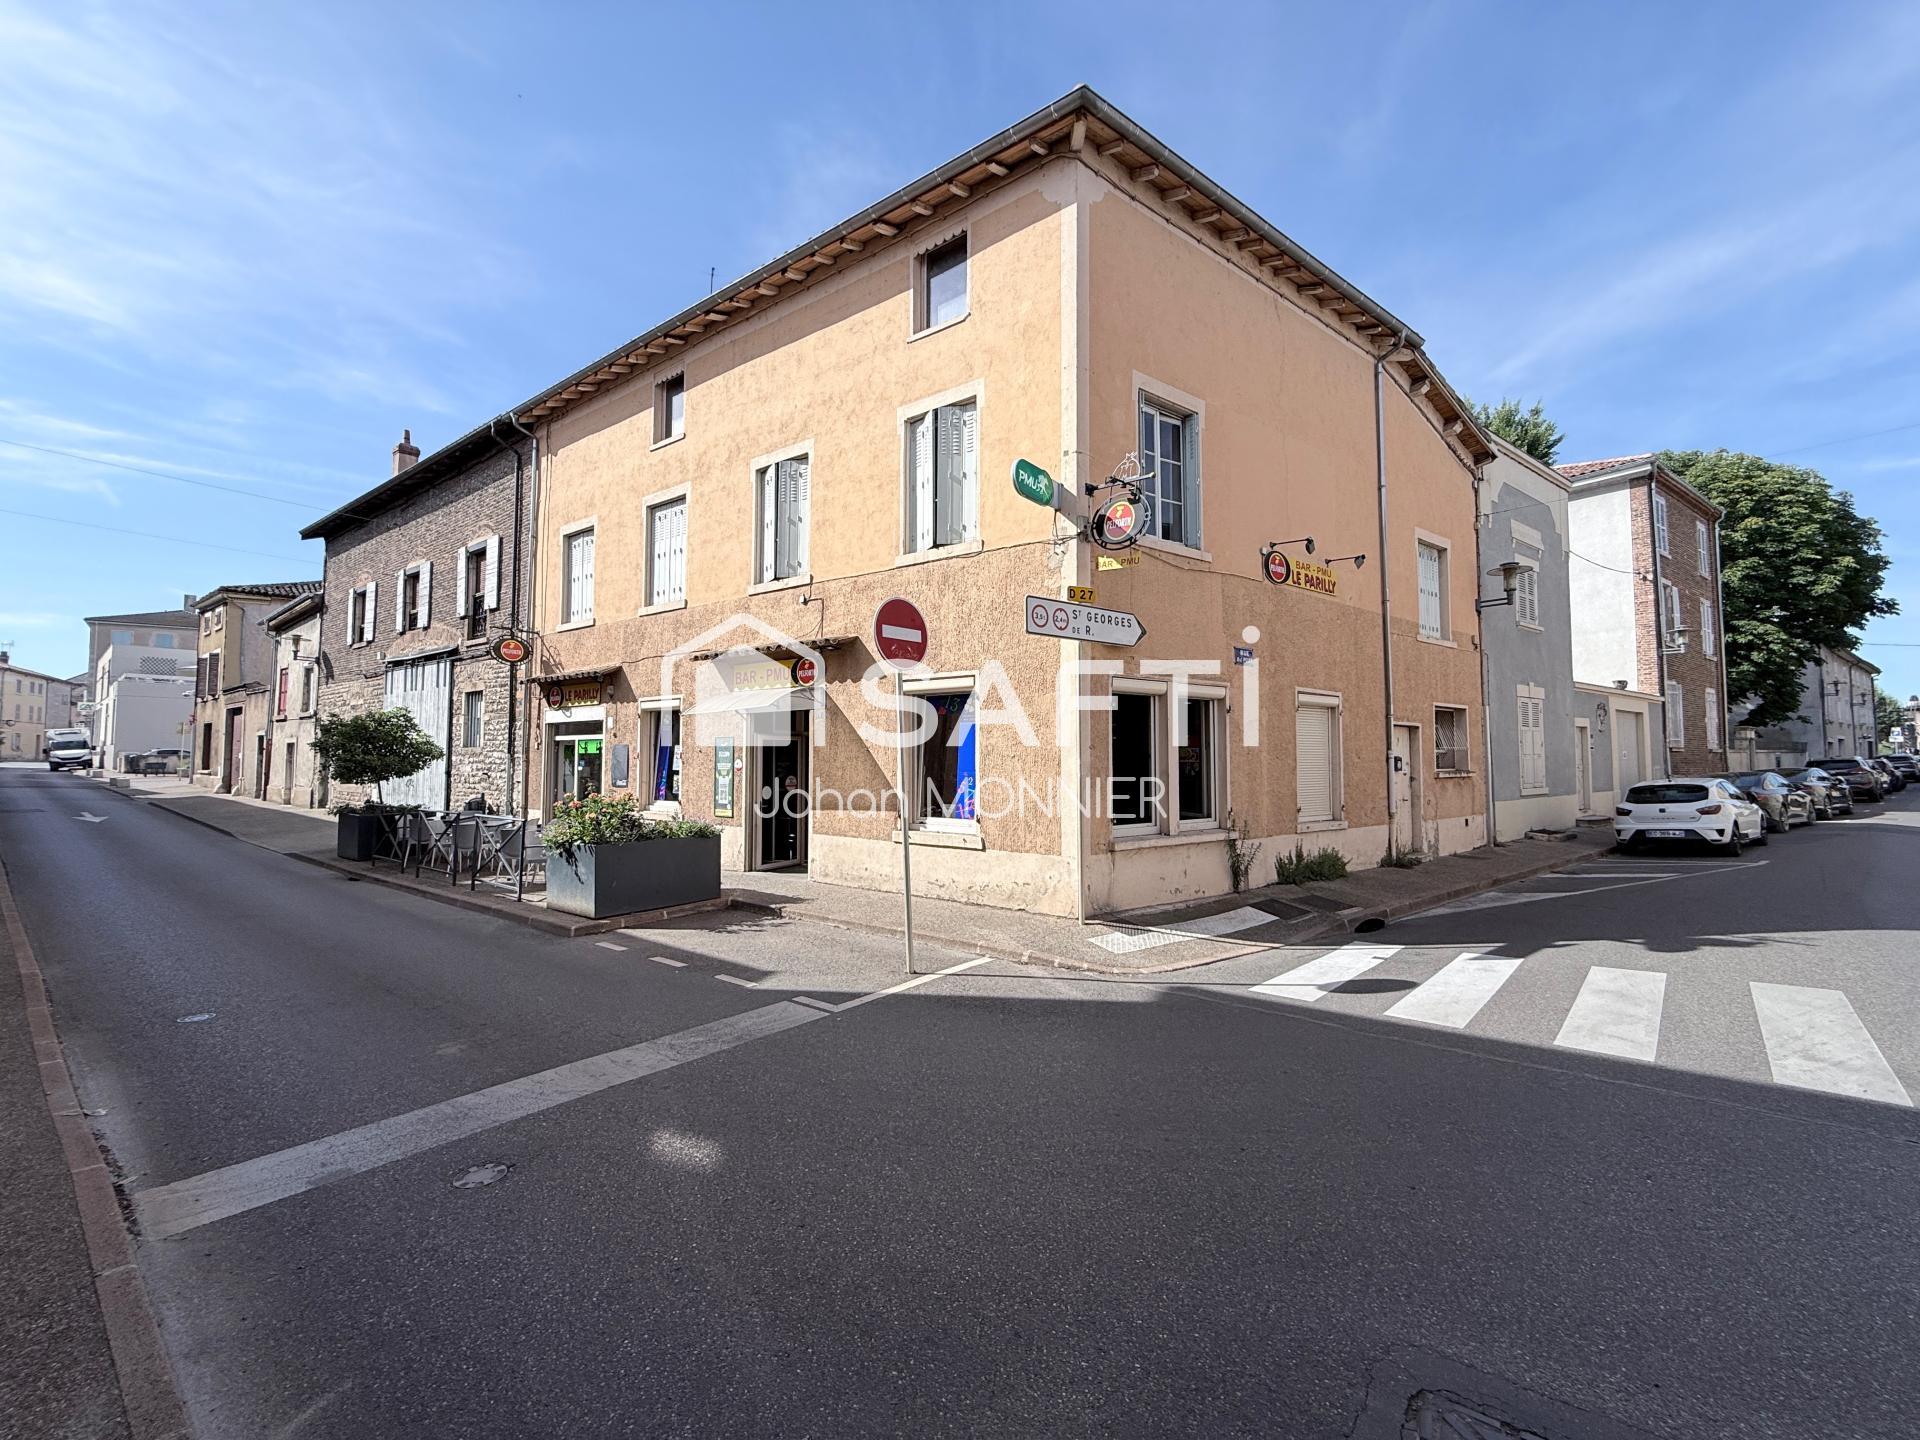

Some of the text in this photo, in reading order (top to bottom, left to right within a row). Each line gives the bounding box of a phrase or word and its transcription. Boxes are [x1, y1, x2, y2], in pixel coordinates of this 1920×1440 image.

[1018, 469, 1038, 489] PMU
[1120, 557, 1140, 566] PMU
[1295, 561, 1311, 572] BAR
[1316, 566, 1332, 578] PMU
[1291, 569, 1337, 594] LE PARILLY
[1069, 588, 1094, 600] D 27
[1086, 612, 1132, 629] GEORGES
[1085, 625, 1095, 637] R.
[735, 670, 757, 685] BAR
[766, 667, 791, 681] PMU
[565, 691, 572, 702] LE
[573, 687, 600, 701] PARILLY
